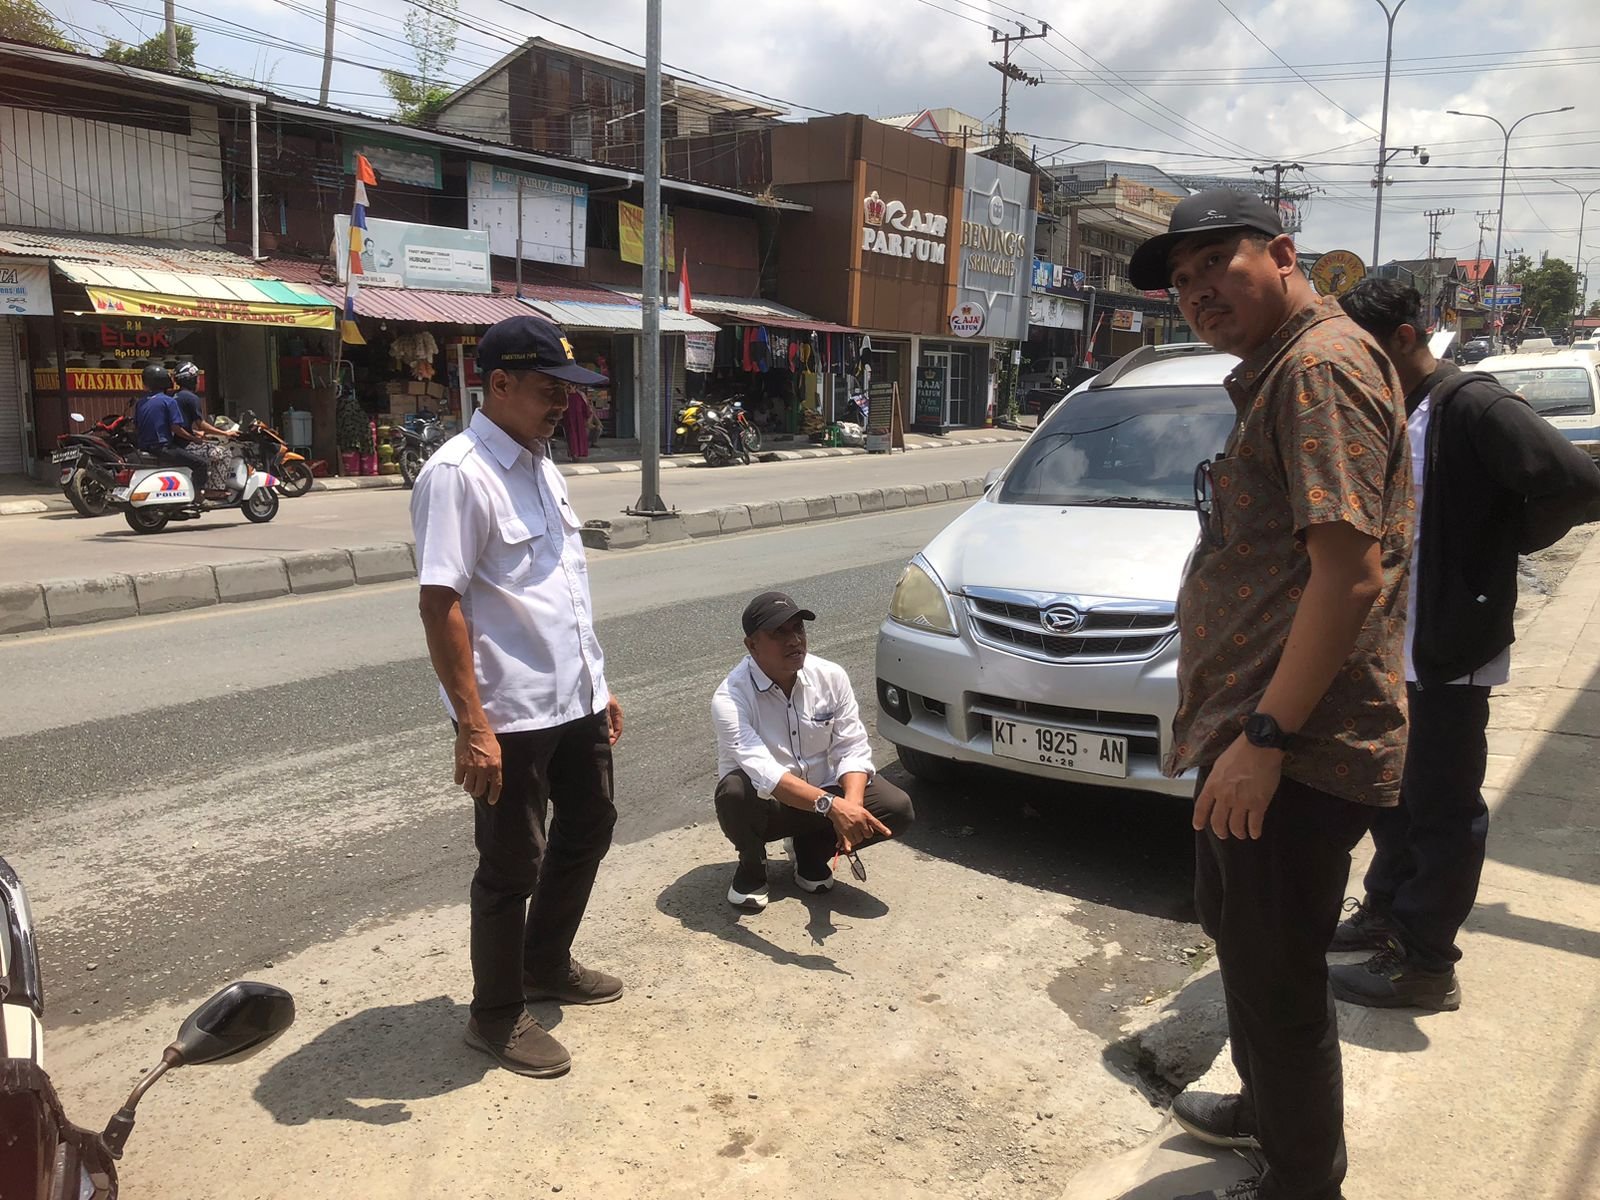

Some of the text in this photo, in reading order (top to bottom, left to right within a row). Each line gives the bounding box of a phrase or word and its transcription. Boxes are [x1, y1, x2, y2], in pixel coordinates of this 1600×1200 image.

[495, 171, 513, 184] ABU
[862, 227, 946, 264] PARFUM
[968, 253, 1015, 277] SKINCARE
[139, 303, 227, 319] MASAKAN
[231, 312, 296, 323] PADANG
[951, 315, 980, 325] RAJA
[101, 323, 169, 347] ELOK
[115, 348, 150, 358] Rp15000
[74, 373, 144, 390] MASAKAN
[1536, 371, 1544, 380] 3
[917, 380, 940, 389] RAJA
[995, 720, 1124, 764] KT 1925 AN
